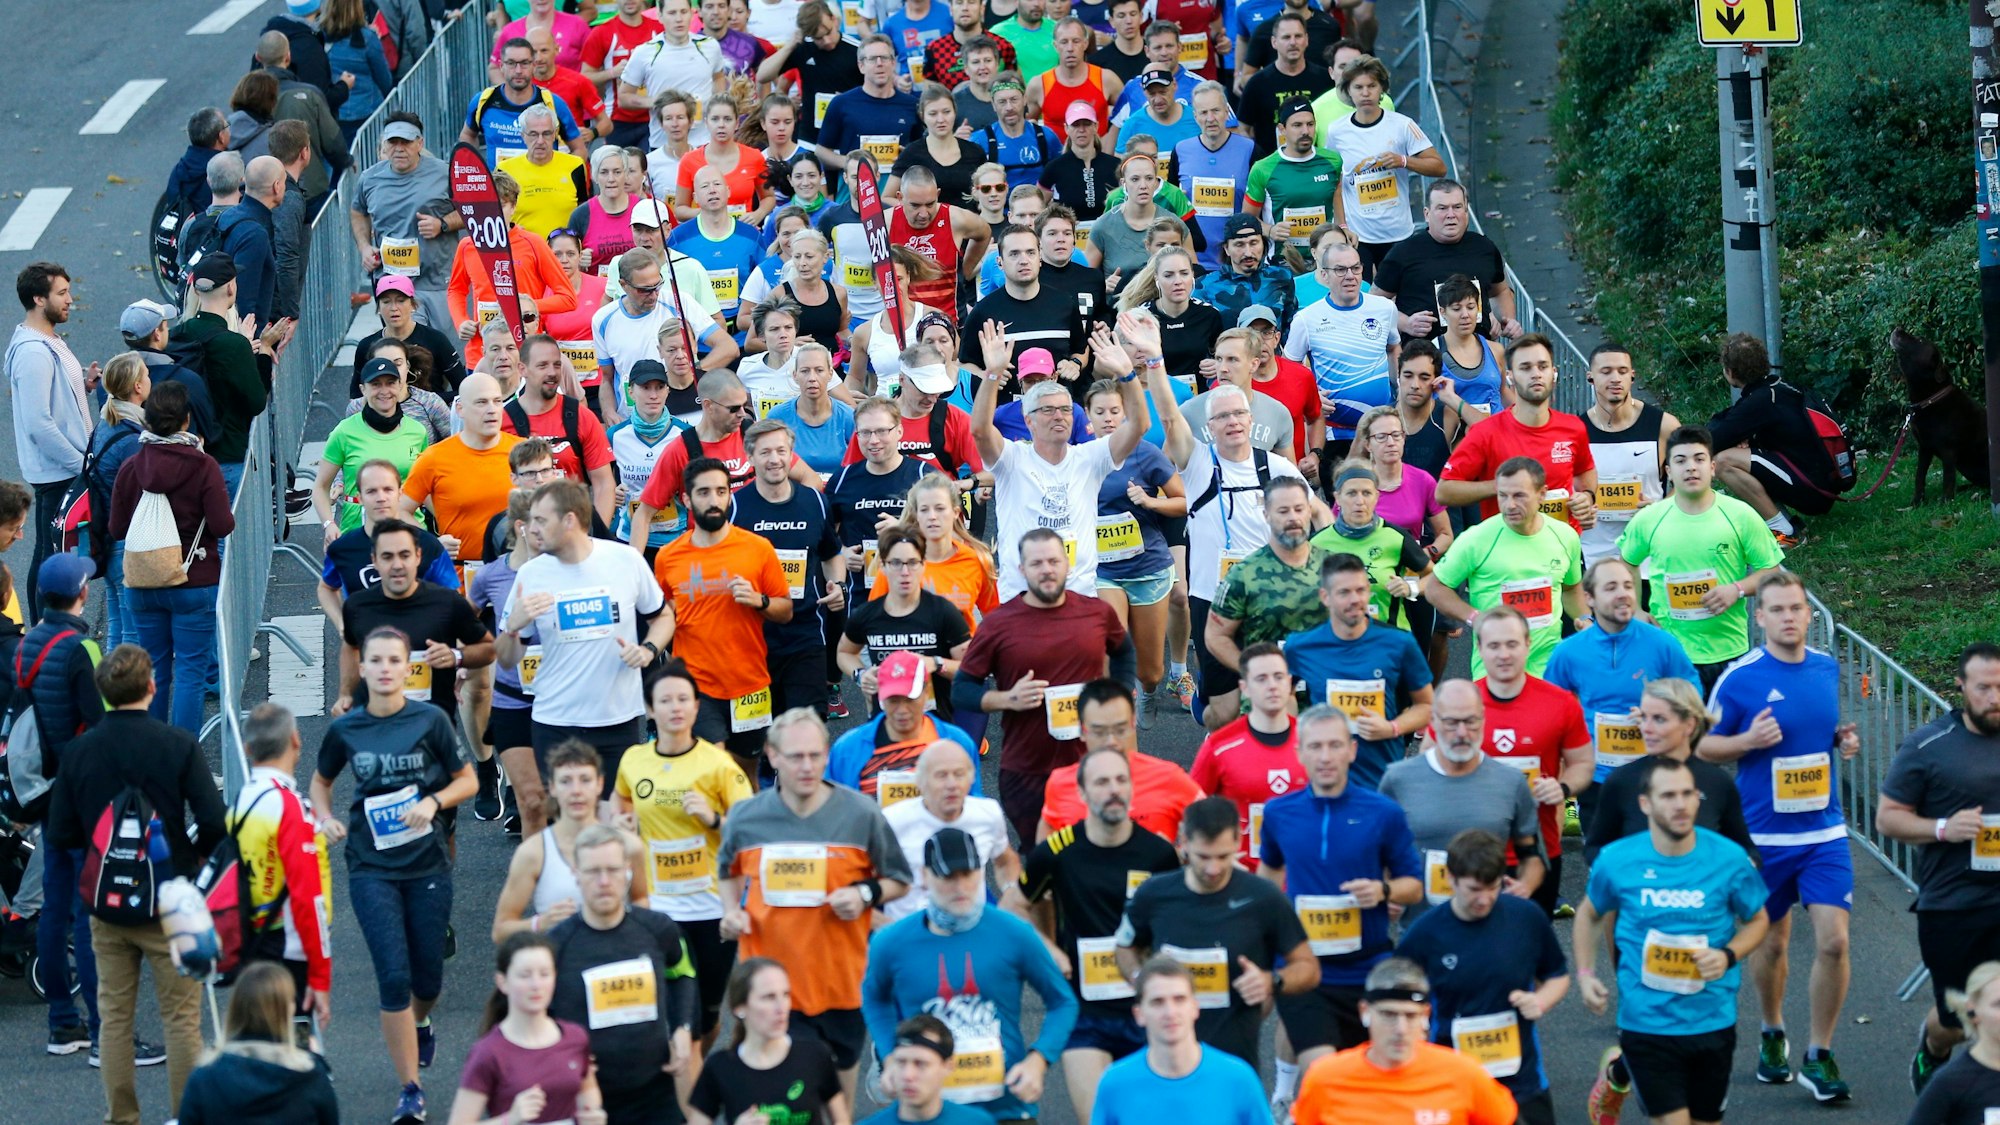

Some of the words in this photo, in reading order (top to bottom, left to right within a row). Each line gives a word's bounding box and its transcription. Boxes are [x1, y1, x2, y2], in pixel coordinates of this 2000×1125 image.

[868, 146, 895, 155] 11275
[1200, 188, 1228, 197] 19015
[1360, 180, 1392, 194] F19017
[462, 206, 475, 216] SUB
[468, 216, 507, 249] 2:00
[387, 248, 413, 257] 14887
[848, 267, 870, 278] 1677
[561, 350, 594, 361] 19444
[622, 473, 651, 482] MARATH
[1599, 486, 1634, 497] 18415
[1097, 524, 1134, 540] F21177
[1108, 540, 1128, 549] Isabel
[1673, 584, 1709, 597] 24769
[1509, 591, 1546, 606] 24770
[564, 600, 603, 615] 18045
[574, 618, 596, 627] Klaus
[867, 635, 884, 647] WE
[885, 634, 908, 646] RUN
[909, 633, 938, 645] THIS
[1338, 695, 1377, 707] 17762
[380, 753, 424, 776] XLETIX
[1784, 770, 1823, 785] 21608
[1984, 829, 2000, 842] 24
[657, 851, 700, 868] F26137
[773, 862, 815, 876] 20051
[114, 876, 133, 885] REWE
[1308, 911, 1351, 926] 19179
[600, 978, 643, 994] 24219
[1467, 1031, 1510, 1050] 15641
